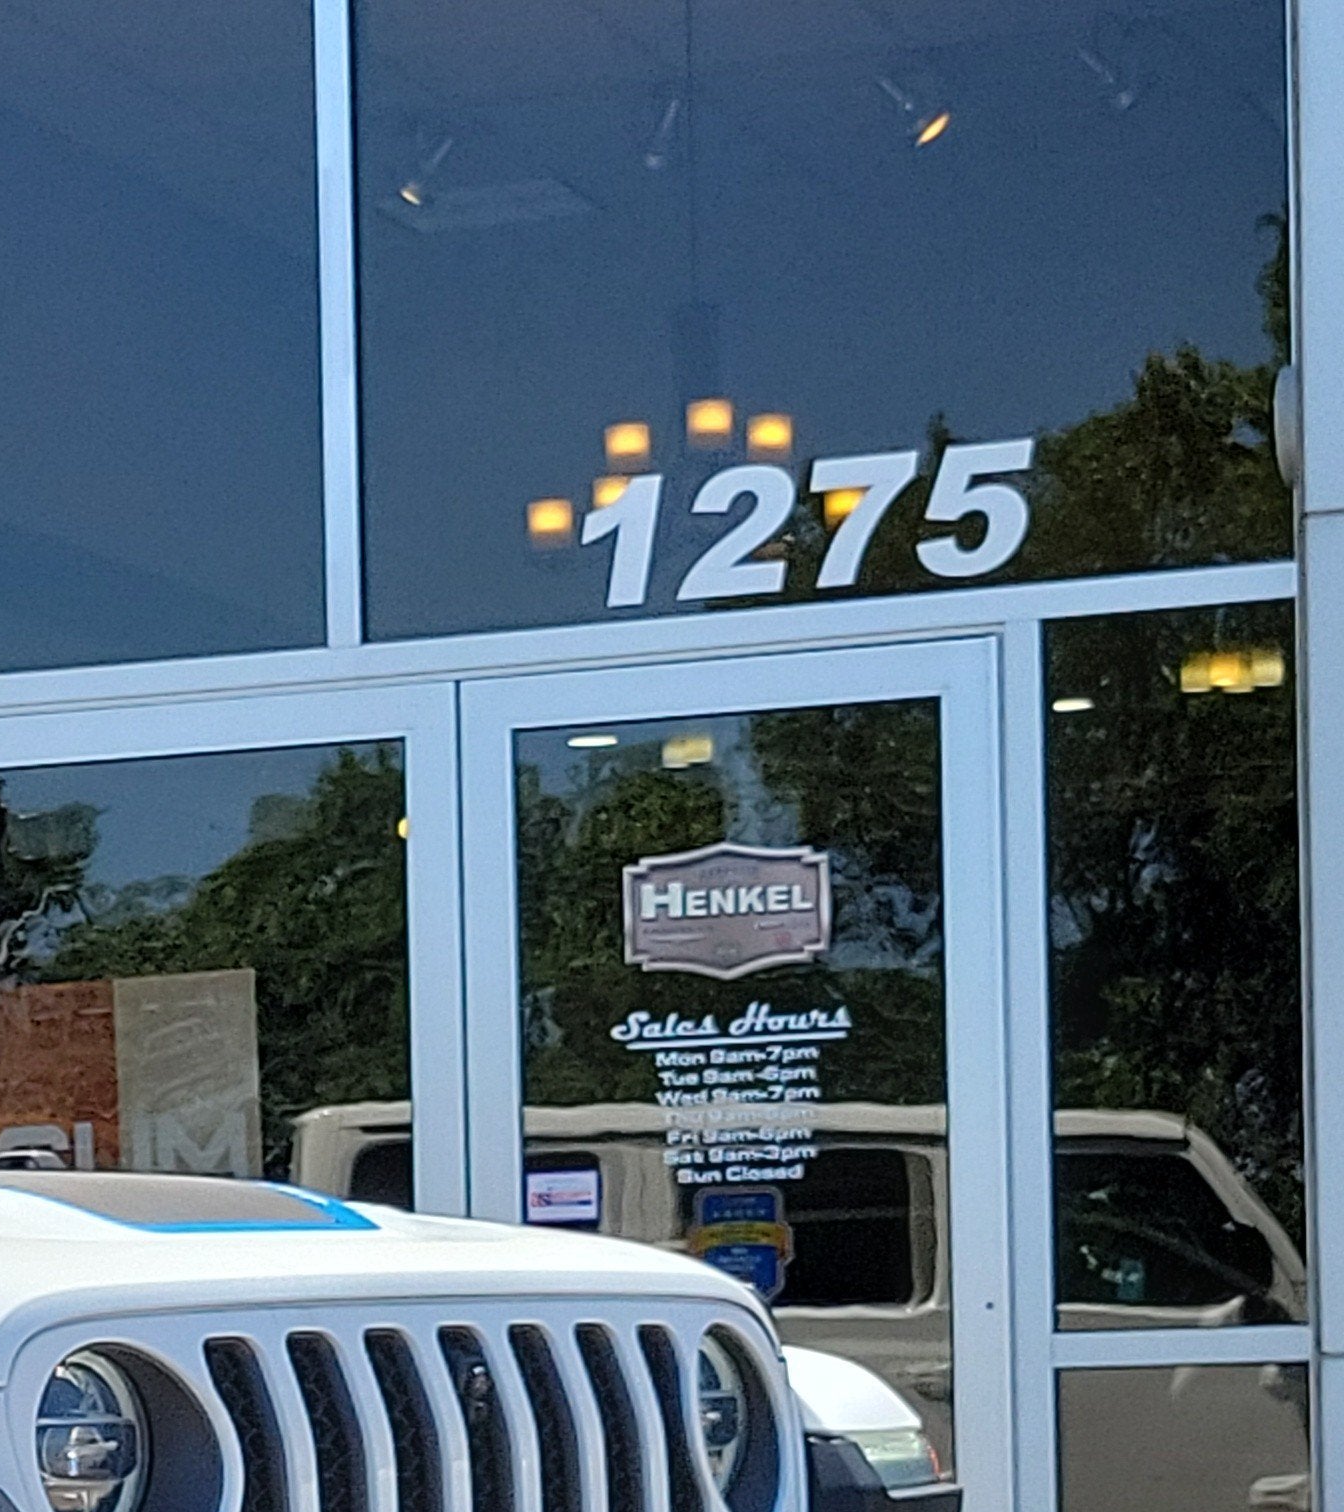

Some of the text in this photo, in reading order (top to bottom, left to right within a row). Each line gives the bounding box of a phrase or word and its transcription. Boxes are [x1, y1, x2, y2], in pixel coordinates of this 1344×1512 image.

[580, 438, 1034, 608] 1275
[640, 882, 814, 920] HENKEL
[610, 1001, 853, 1042] Sales Hours
[655, 1051, 706, 1067] Mon
[657, 1071, 699, 1086] Tue
[655, 1089, 708, 1108] Wed
[666, 1130, 699, 1145] Fri
[663, 1149, 704, 1165] Sat
[677, 1163, 804, 1184] Sun Closed
